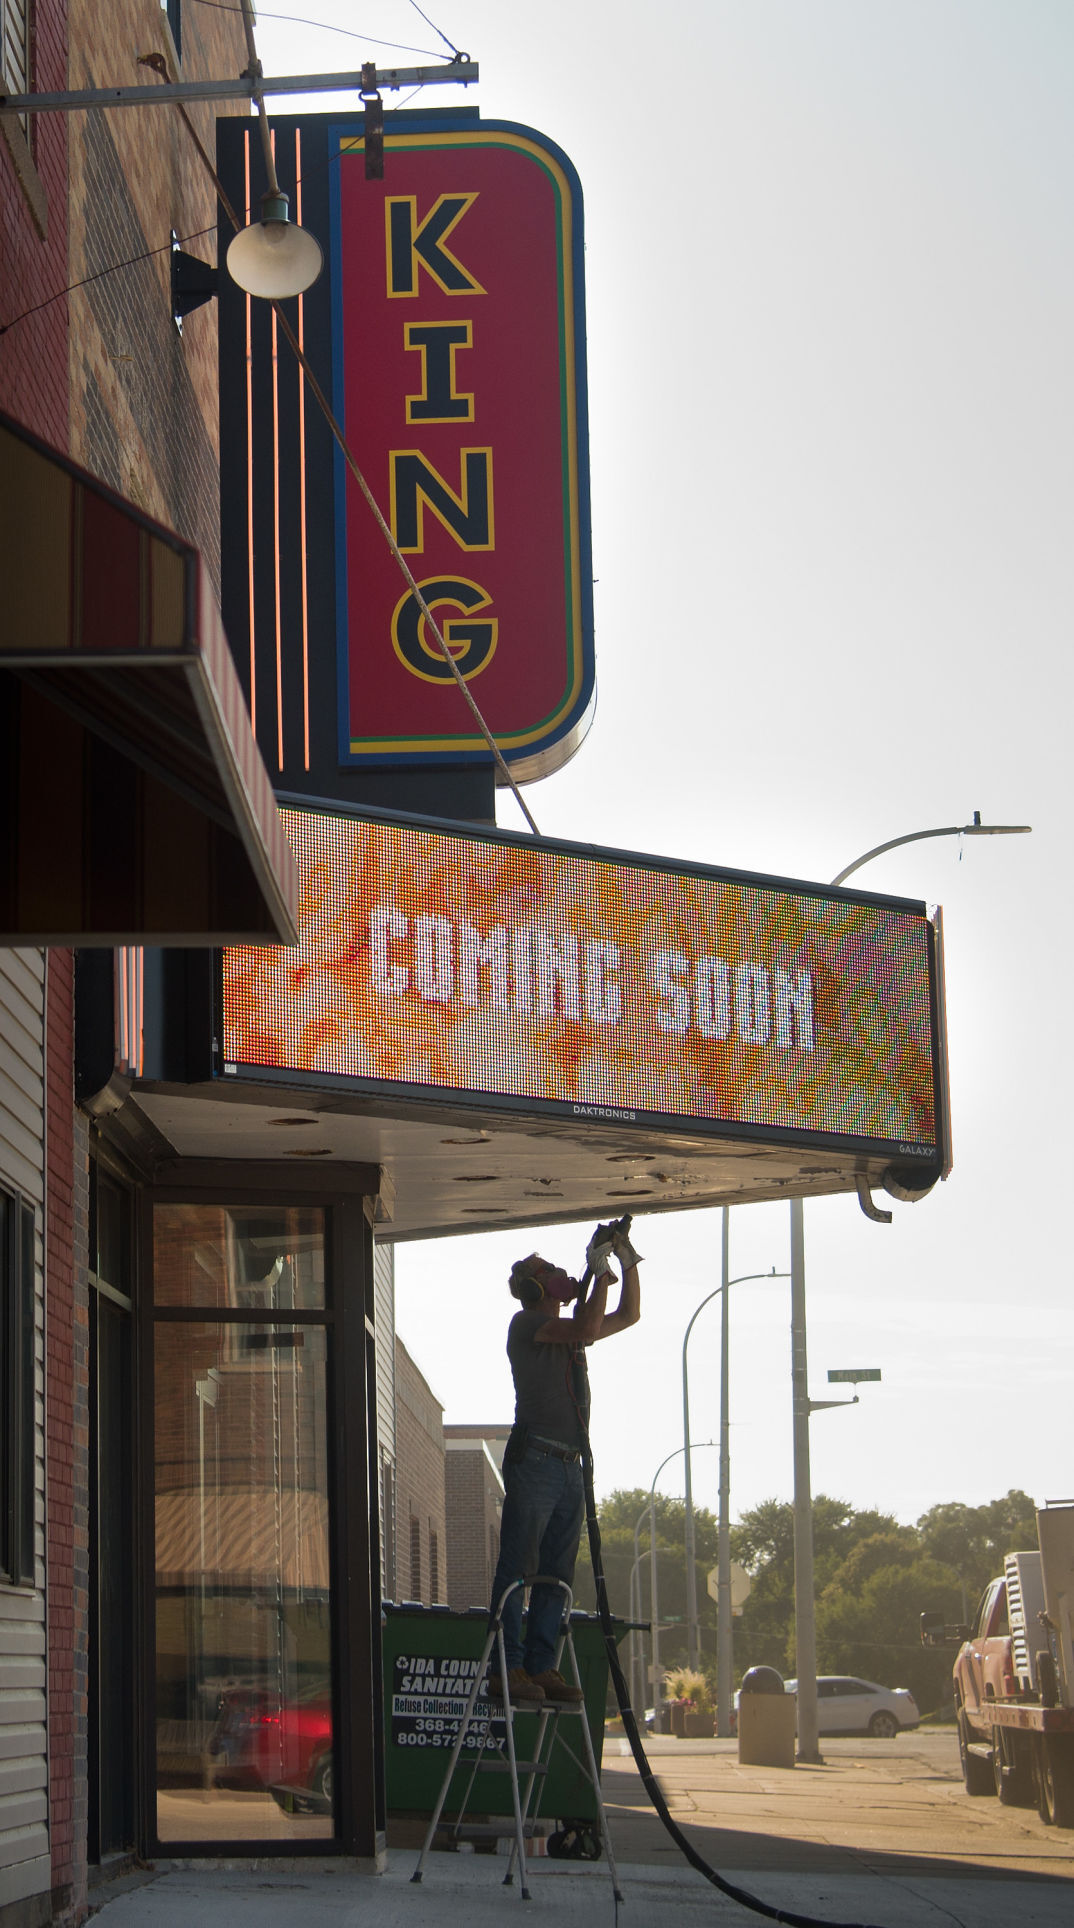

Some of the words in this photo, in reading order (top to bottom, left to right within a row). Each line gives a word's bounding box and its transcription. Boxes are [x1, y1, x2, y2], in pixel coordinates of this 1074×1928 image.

[384, 192, 499, 685] KING
[371, 904, 622, 1025] COMING
[655, 949, 814, 1052] SOON
[573, 1105, 636, 1120] DAKTRONICS
[899, 1144, 935, 1157] GALAXY
[409, 1658, 435, 1675] IDA
[394, 1697, 422, 1713] Refuse
[423, 1698, 464, 1715] Collection
[415, 1718, 489, 1734] 368-446
